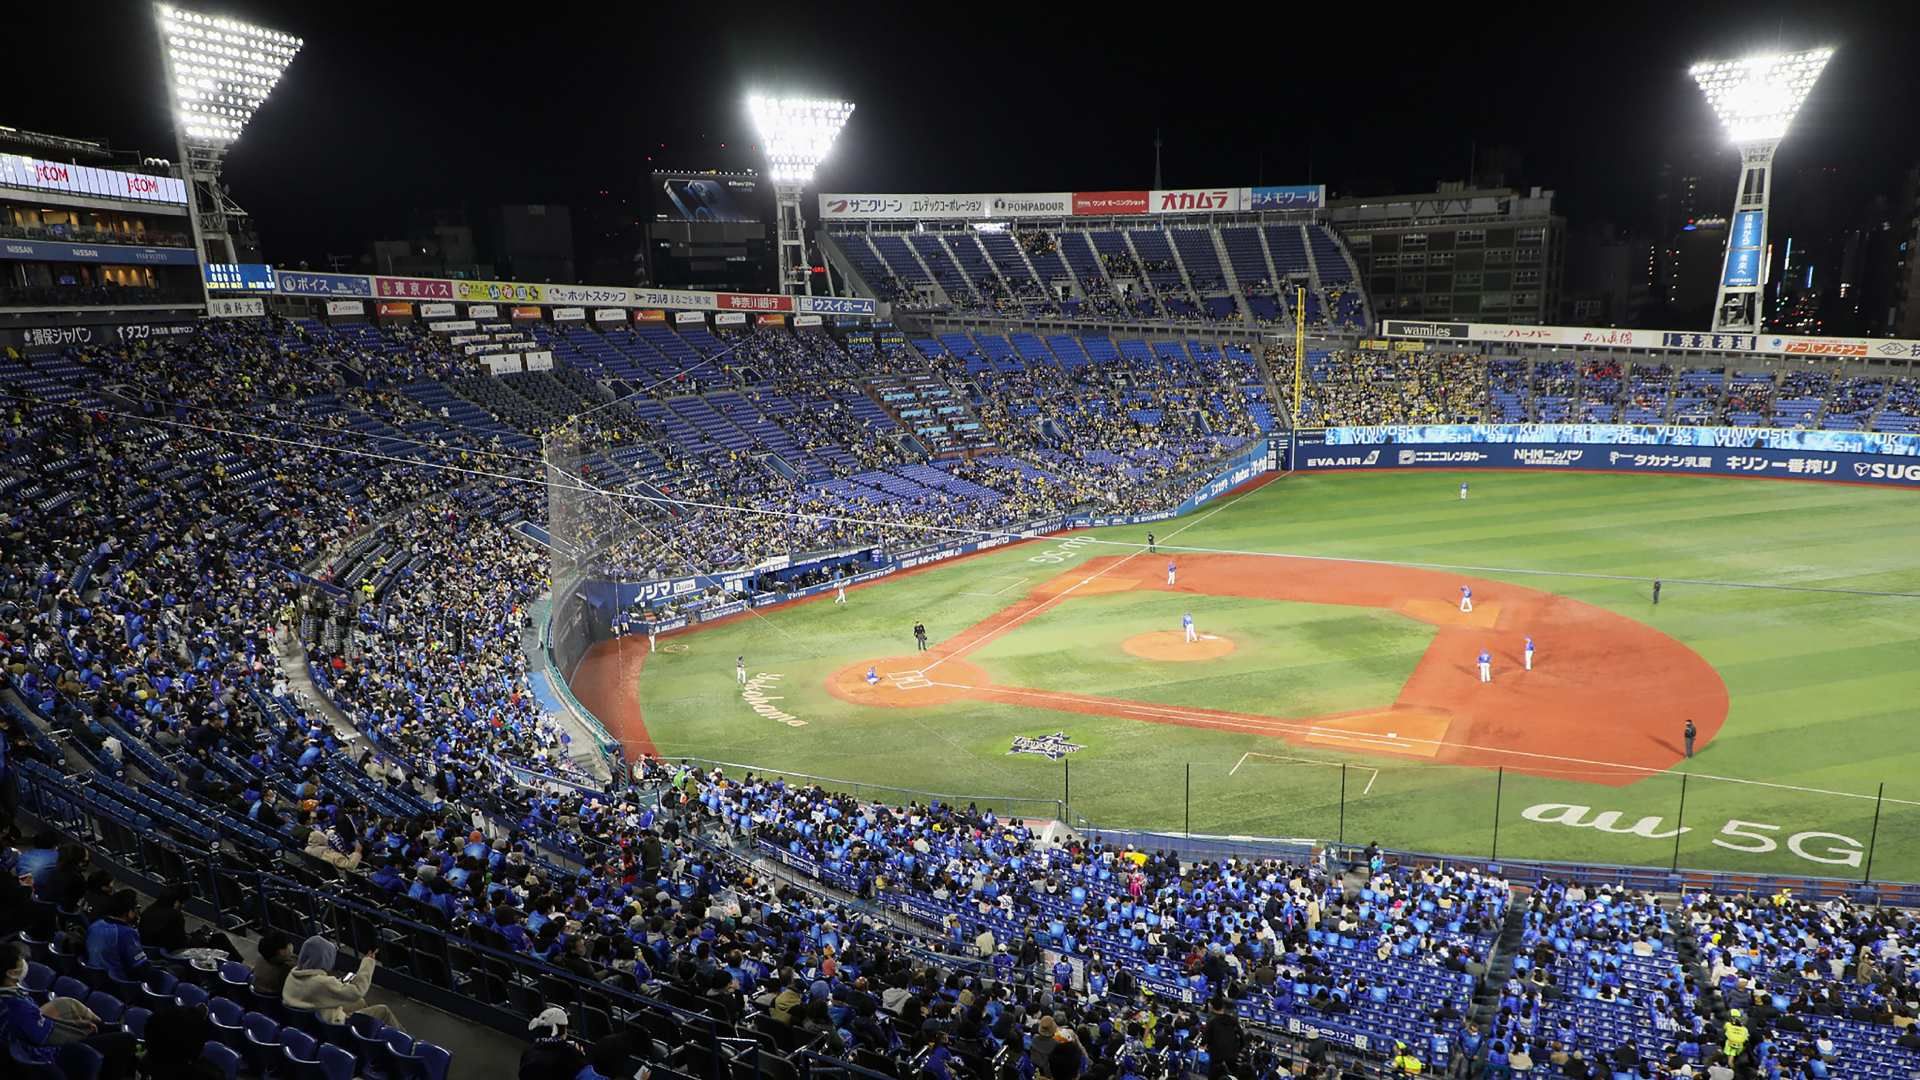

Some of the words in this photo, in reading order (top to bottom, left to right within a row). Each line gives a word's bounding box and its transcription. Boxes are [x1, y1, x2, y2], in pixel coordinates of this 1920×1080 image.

[36, 165, 69, 183] J:COM
[127, 178, 159, 194] J:COM
[1161, 192, 1228, 210] オカムラ
[1260, 191, 1318, 206] メモワール
[850, 200, 902, 213] サニクリーン
[1007, 201, 1064, 211] POMPADOUR
[7, 245, 33, 255] NISSAN
[72, 248, 98, 257] NISSAN
[297, 278, 330, 291] ボイス
[395, 278, 449, 296] 東京バス
[568, 291, 626, 302] ホットスタッフ
[731, 297, 780, 310] 神奈川銀行
[814, 298, 873, 313] ウスイホーム
[32, 327, 92, 346] 損保ジャパン
[126, 325, 150, 339] タスク
[1403, 324, 1450, 337] wamiles
[1416, 451, 1488, 463] ニコニコレンタカー
[1634, 454, 1712, 468] タカナシ乳業
[634, 581, 671, 603] ノジマ
[1521, 802, 1692, 838] au
[1711, 819, 1865, 868] 5G
